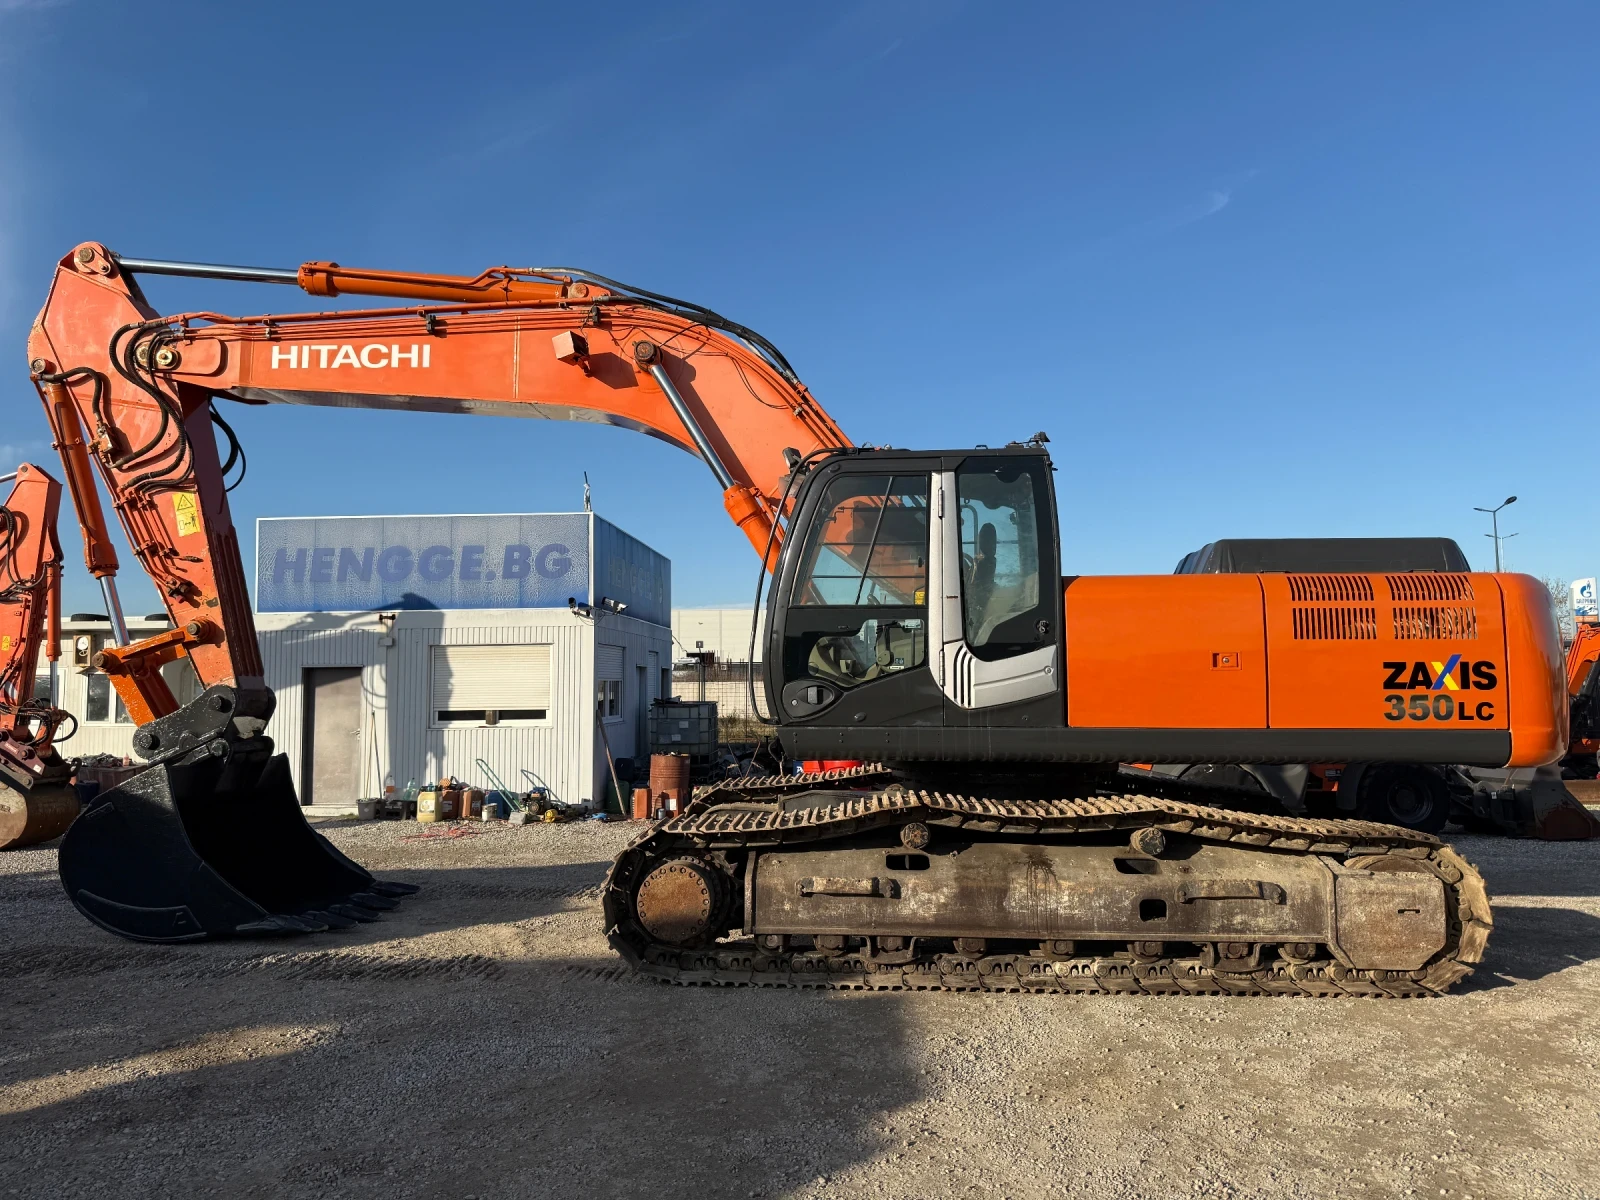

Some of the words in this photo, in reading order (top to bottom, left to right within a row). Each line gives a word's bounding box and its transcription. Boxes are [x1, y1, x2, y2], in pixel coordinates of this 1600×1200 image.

[271, 344, 431, 369] HITACHI
[273, 544, 573, 583] HENGGE.BG
[1383, 654, 1497, 690] ZAXIS
